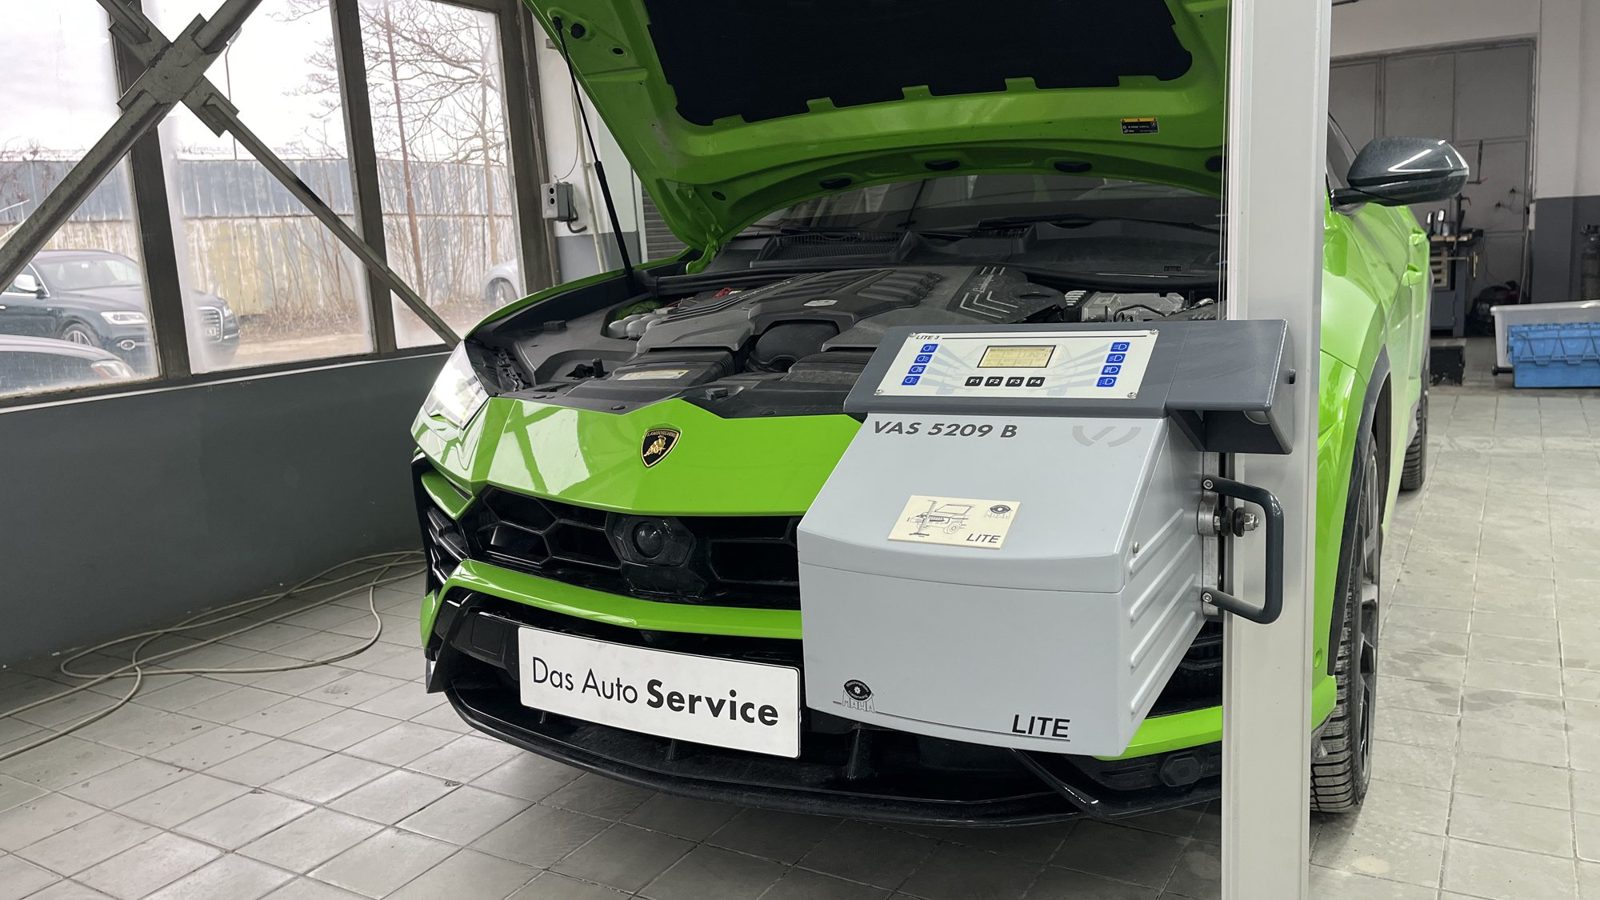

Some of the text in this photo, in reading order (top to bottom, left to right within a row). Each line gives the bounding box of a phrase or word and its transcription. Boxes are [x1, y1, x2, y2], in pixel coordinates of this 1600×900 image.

[874, 421, 1018, 438] VAS 5209 B
[966, 532, 1001, 544] LITE
[531, 656, 779, 727] Das Auto Service
[1011, 714, 1071, 738] LITE
